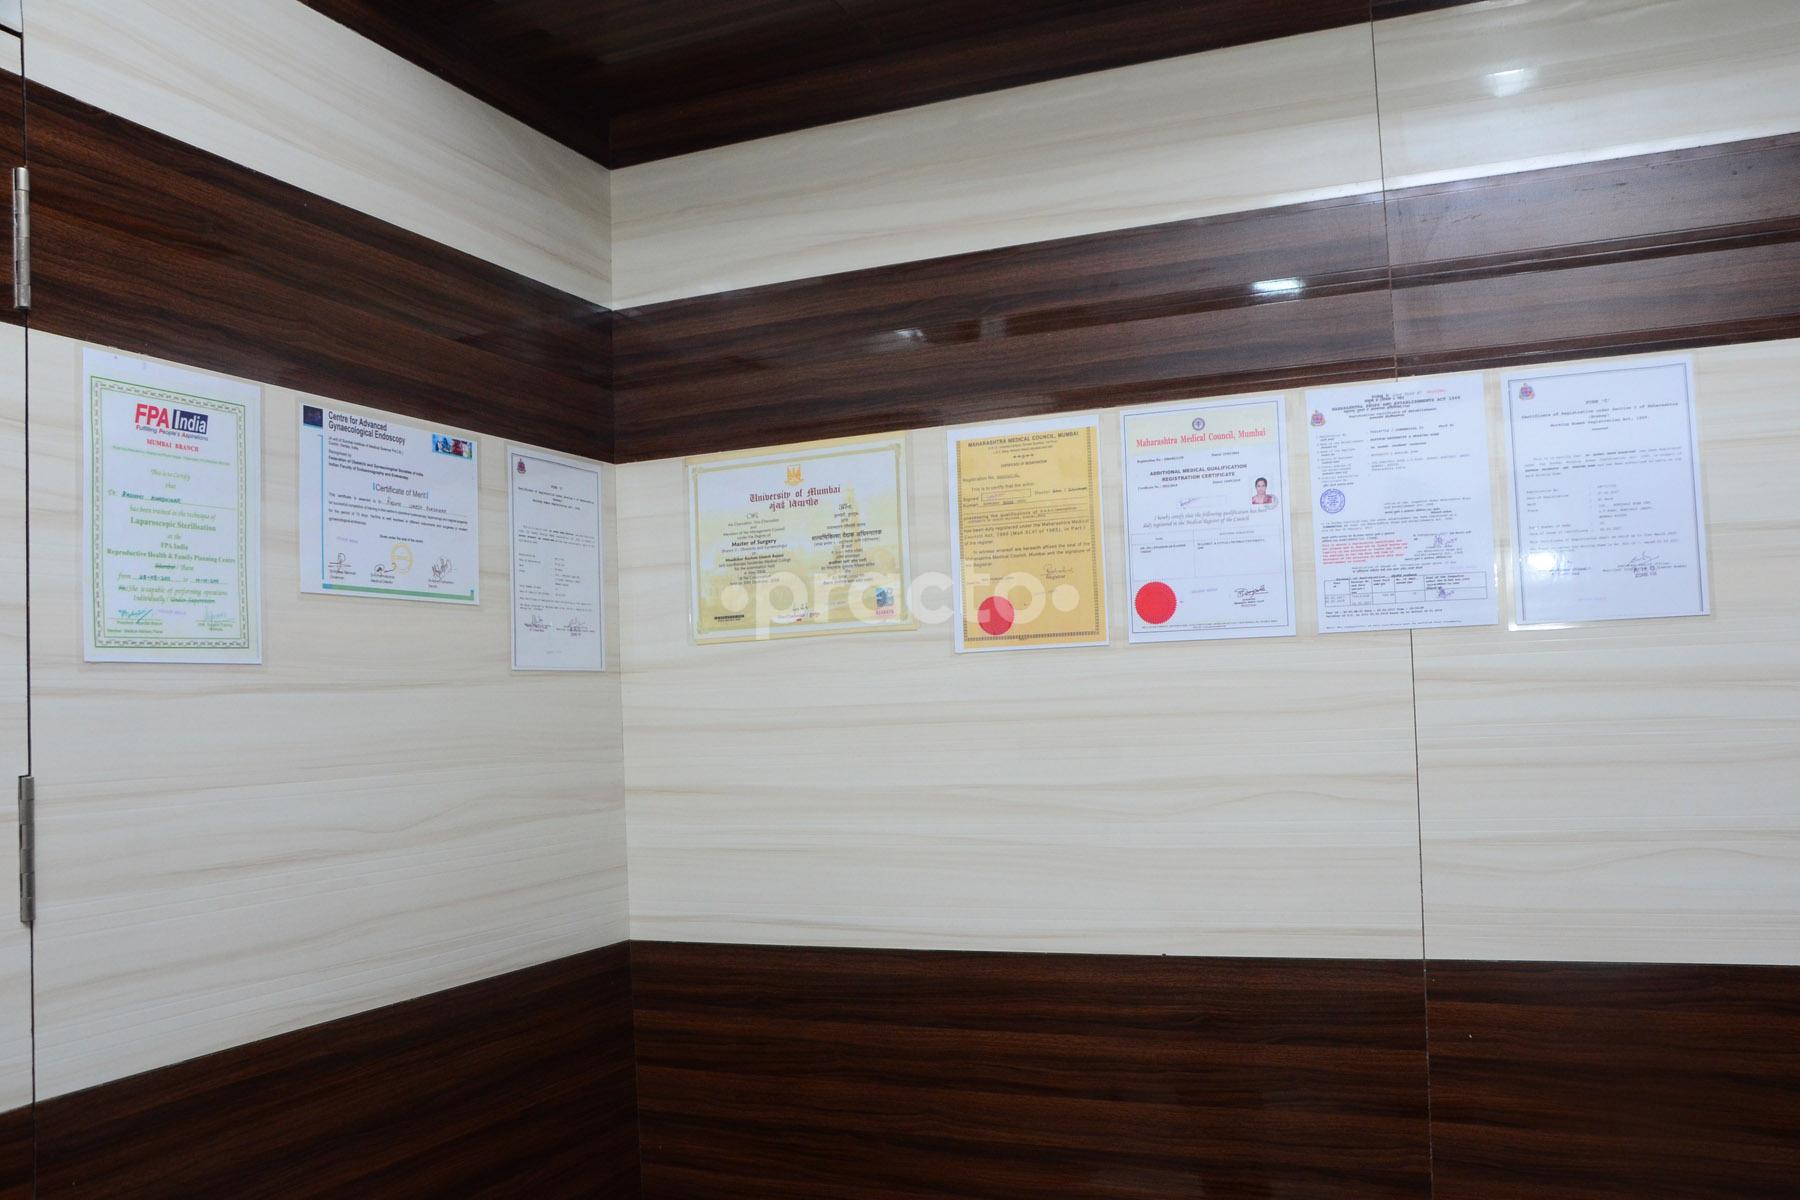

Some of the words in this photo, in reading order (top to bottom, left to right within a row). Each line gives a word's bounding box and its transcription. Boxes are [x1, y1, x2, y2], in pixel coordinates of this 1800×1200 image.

[134, 403, 170, 429] FPA
[174, 410, 207, 434] India
[328, 411, 348, 424] Centre
[349, 415, 358, 425] for
[359, 418, 388, 432] Advanced
[329, 420, 373, 438] Gynaecological
[374, 430, 406, 446] Endoscopy
[968, 438, 1006, 447] MAHARASHTRA
[1031, 433, 1057, 441] COUNCIL,
[1136, 437, 1178, 448] Maharashtra
[1180, 433, 1206, 443] Medical
[1208, 431, 1235, 441] Council,
[1238, 427, 1266, 438] Mumbai
[147, 438, 172, 448] MUMBAI
[175, 443, 199, 453] BRANCH
[1206, 463, 1248, 472] QUALIFICATION
[1161, 474, 1200, 483] REGISTRATION
[1201, 471, 1235, 480] CERTIFICATE
[375, 483, 405, 496] Certificate
[406, 488, 412, 496] of
[749, 491, 791, 503] University
[795, 488, 803, 498] of
[807, 484, 841, 497] Mumbai
[130, 517, 175, 529] Laparoscopic
[757, 538, 776, 547] Surgery
